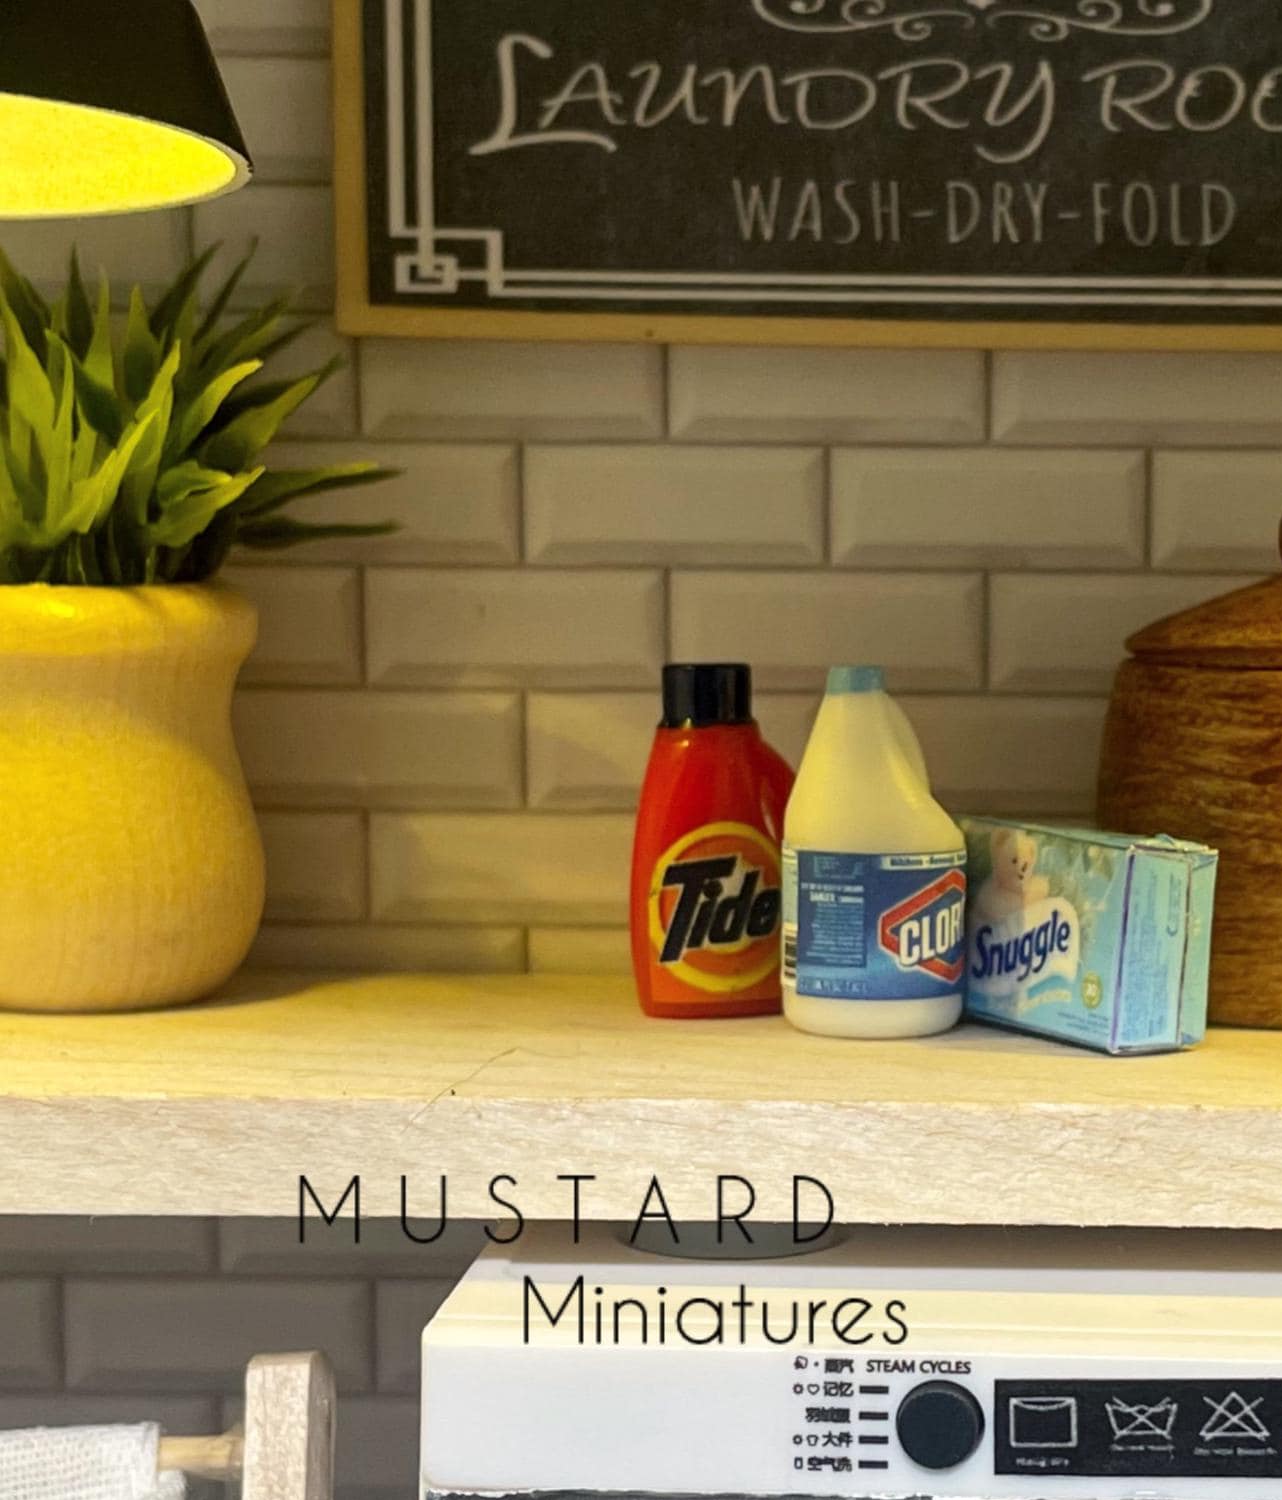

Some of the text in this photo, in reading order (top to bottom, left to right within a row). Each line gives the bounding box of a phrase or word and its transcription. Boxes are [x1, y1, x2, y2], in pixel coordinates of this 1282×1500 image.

[732, 177, 1236, 247] WASH-DRY-FOLD
[660, 855, 782, 963] Tide
[972, 909, 1071, 982] Snuggle
[866, 1359, 972, 1375] STEAM CYCLES
